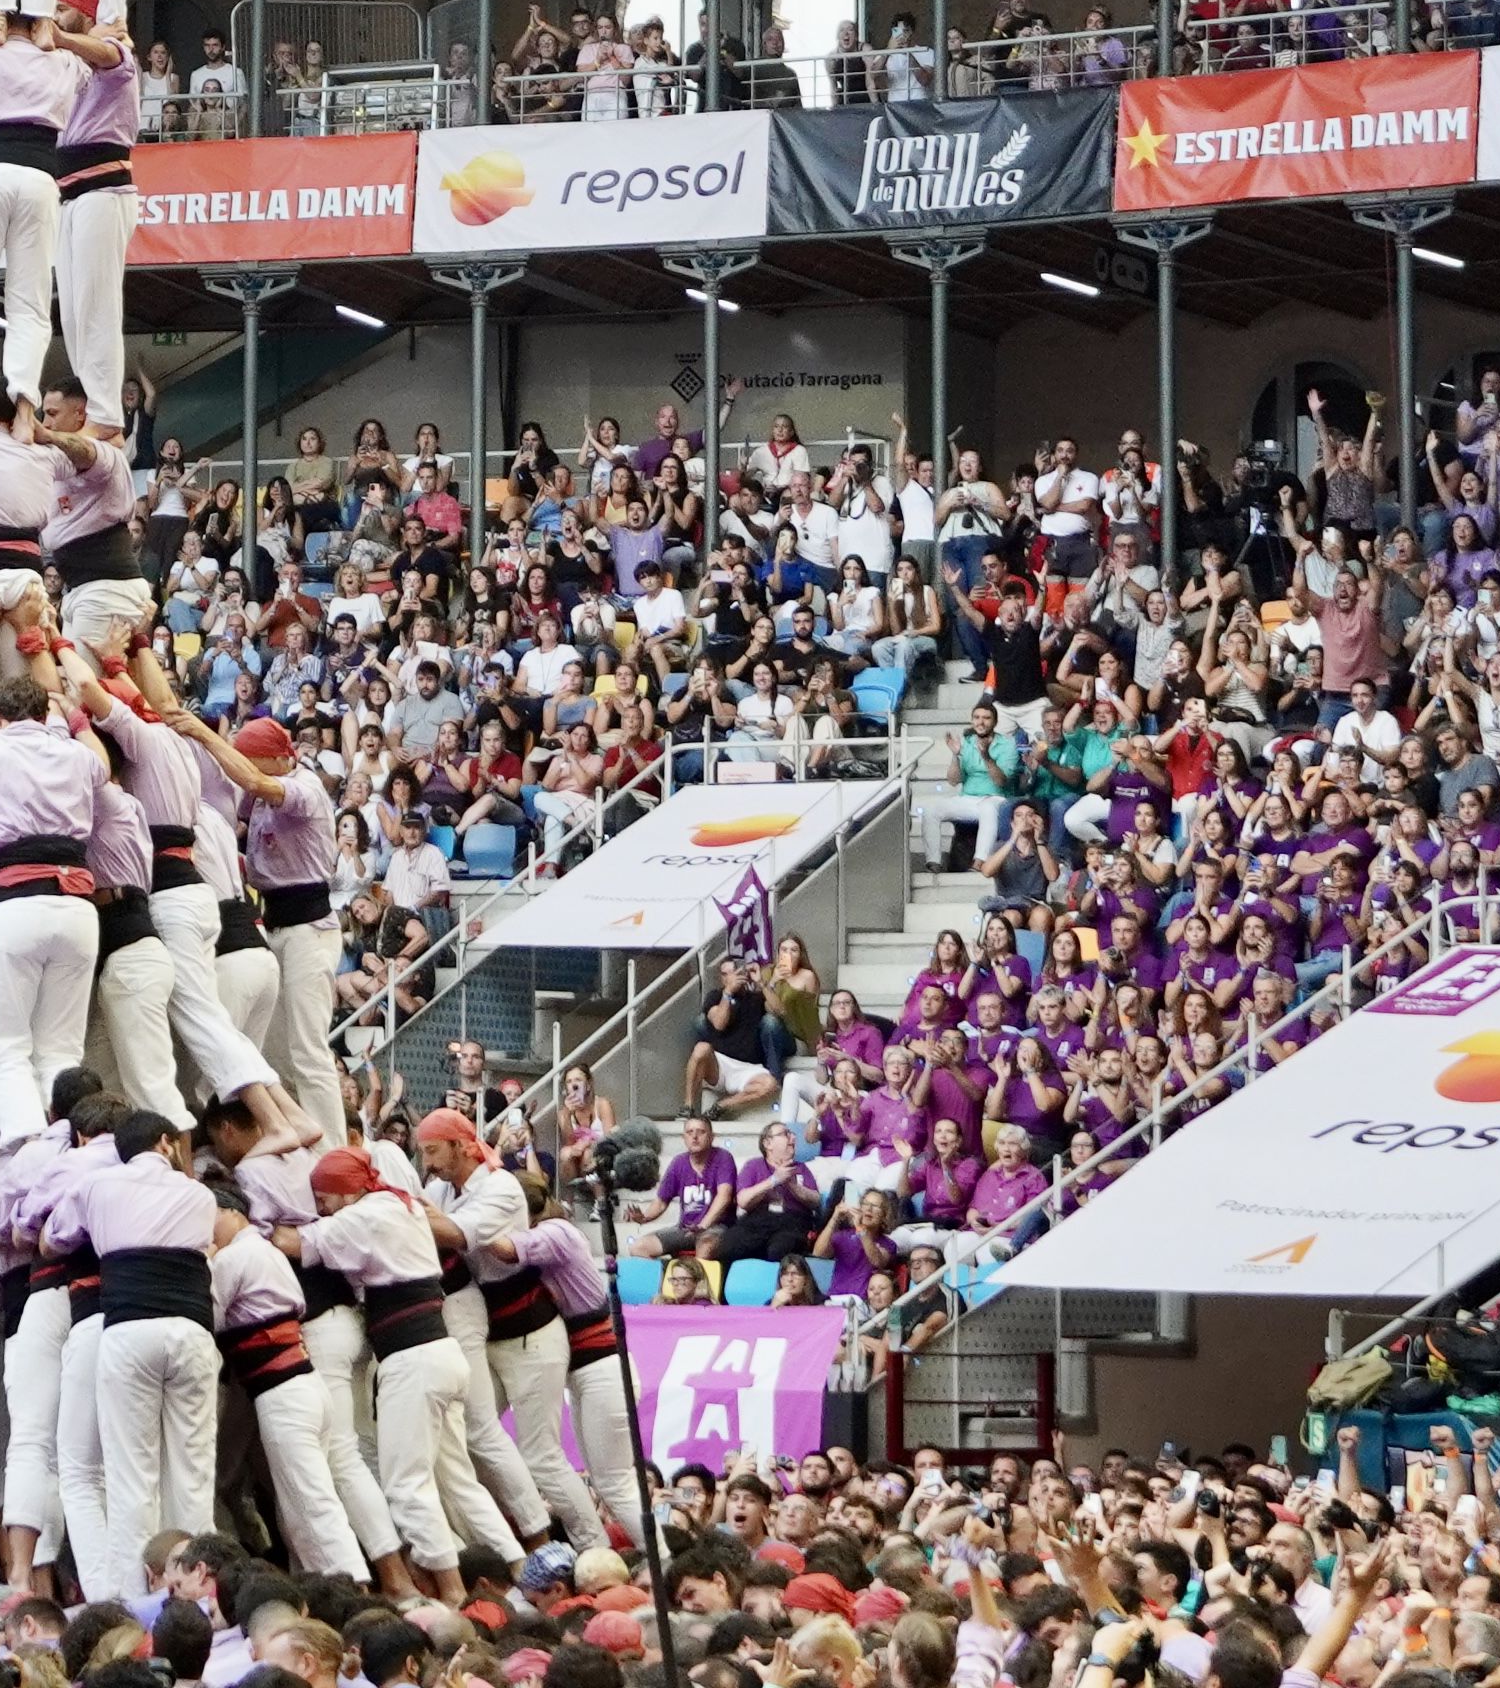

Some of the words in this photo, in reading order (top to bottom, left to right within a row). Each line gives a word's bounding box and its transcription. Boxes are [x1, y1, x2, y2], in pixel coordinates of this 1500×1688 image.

[1174, 117, 1345, 164] ESTRELLA
[1350, 107, 1469, 149] DAMM
[560, 150, 746, 212] repsol
[852, 115, 951, 215] forn
[871, 177, 894, 202] de
[887, 132, 1024, 213] nulles
[136, 188, 287, 226] ESTRELLA
[296, 183, 406, 221] DAMM
[718, 372, 795, 389] Diutació
[798, 372, 882, 391] Tarragona
[642, 852, 770, 868] repsol
